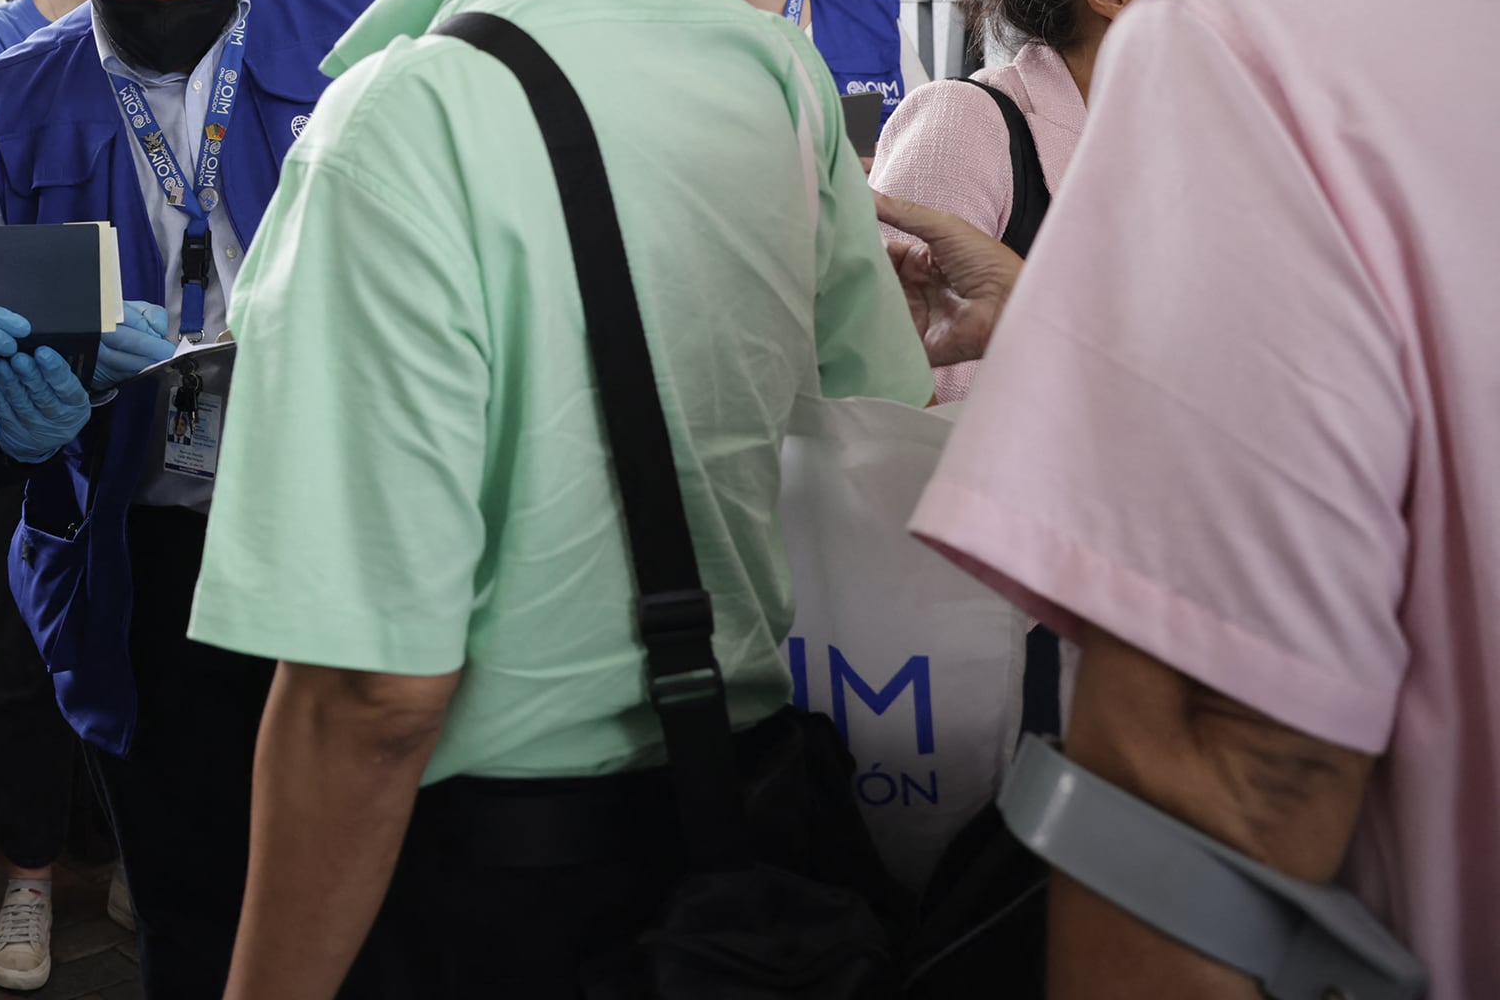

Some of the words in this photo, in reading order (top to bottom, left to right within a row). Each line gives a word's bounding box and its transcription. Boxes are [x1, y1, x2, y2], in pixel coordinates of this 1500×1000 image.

[119, 87, 139, 115] OIM
[218, 85, 234, 115] OIM
[149, 150, 170, 177] OIM
[203, 157, 219, 188] OIM
[788, 637, 935, 755] IM
